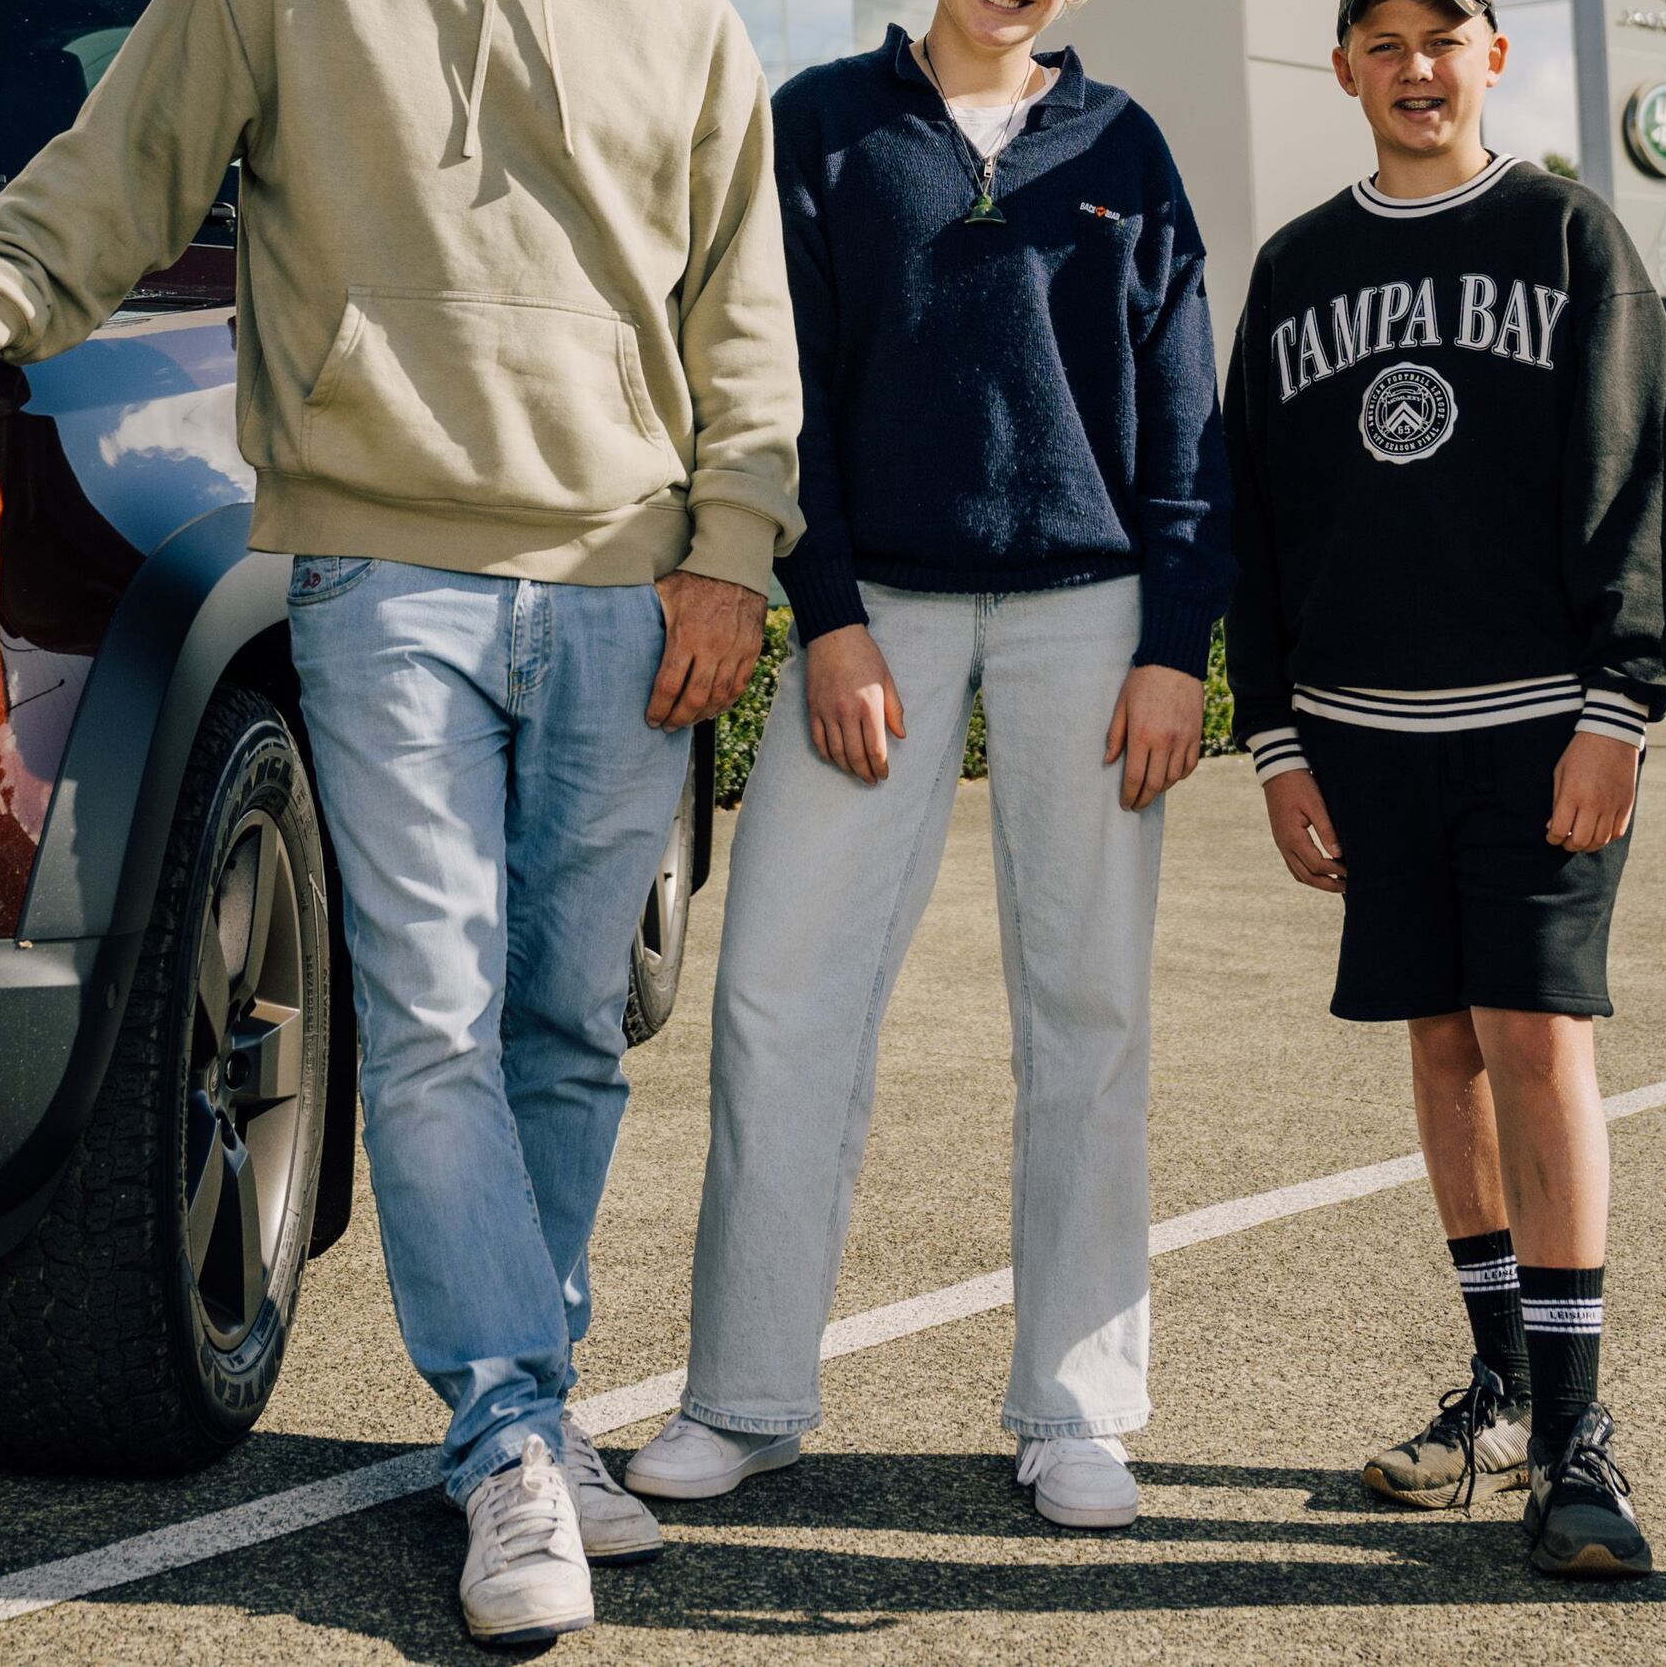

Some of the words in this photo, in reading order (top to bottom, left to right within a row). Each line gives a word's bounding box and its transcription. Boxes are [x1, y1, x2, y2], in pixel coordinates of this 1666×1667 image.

[1270, 277, 1443, 404] TAMPA
[1454, 273, 1570, 370] BAY
[1367, 382, 1386, 427] AMERICAN
[1387, 373, 1430, 387] FOOTBALL
[1430, 385, 1446, 419] LEAGUE
[1384, 442, 1416, 451] SEASON
[1417, 427, 1440, 447] FINAL
[1397, 424, 1411, 435] 65
